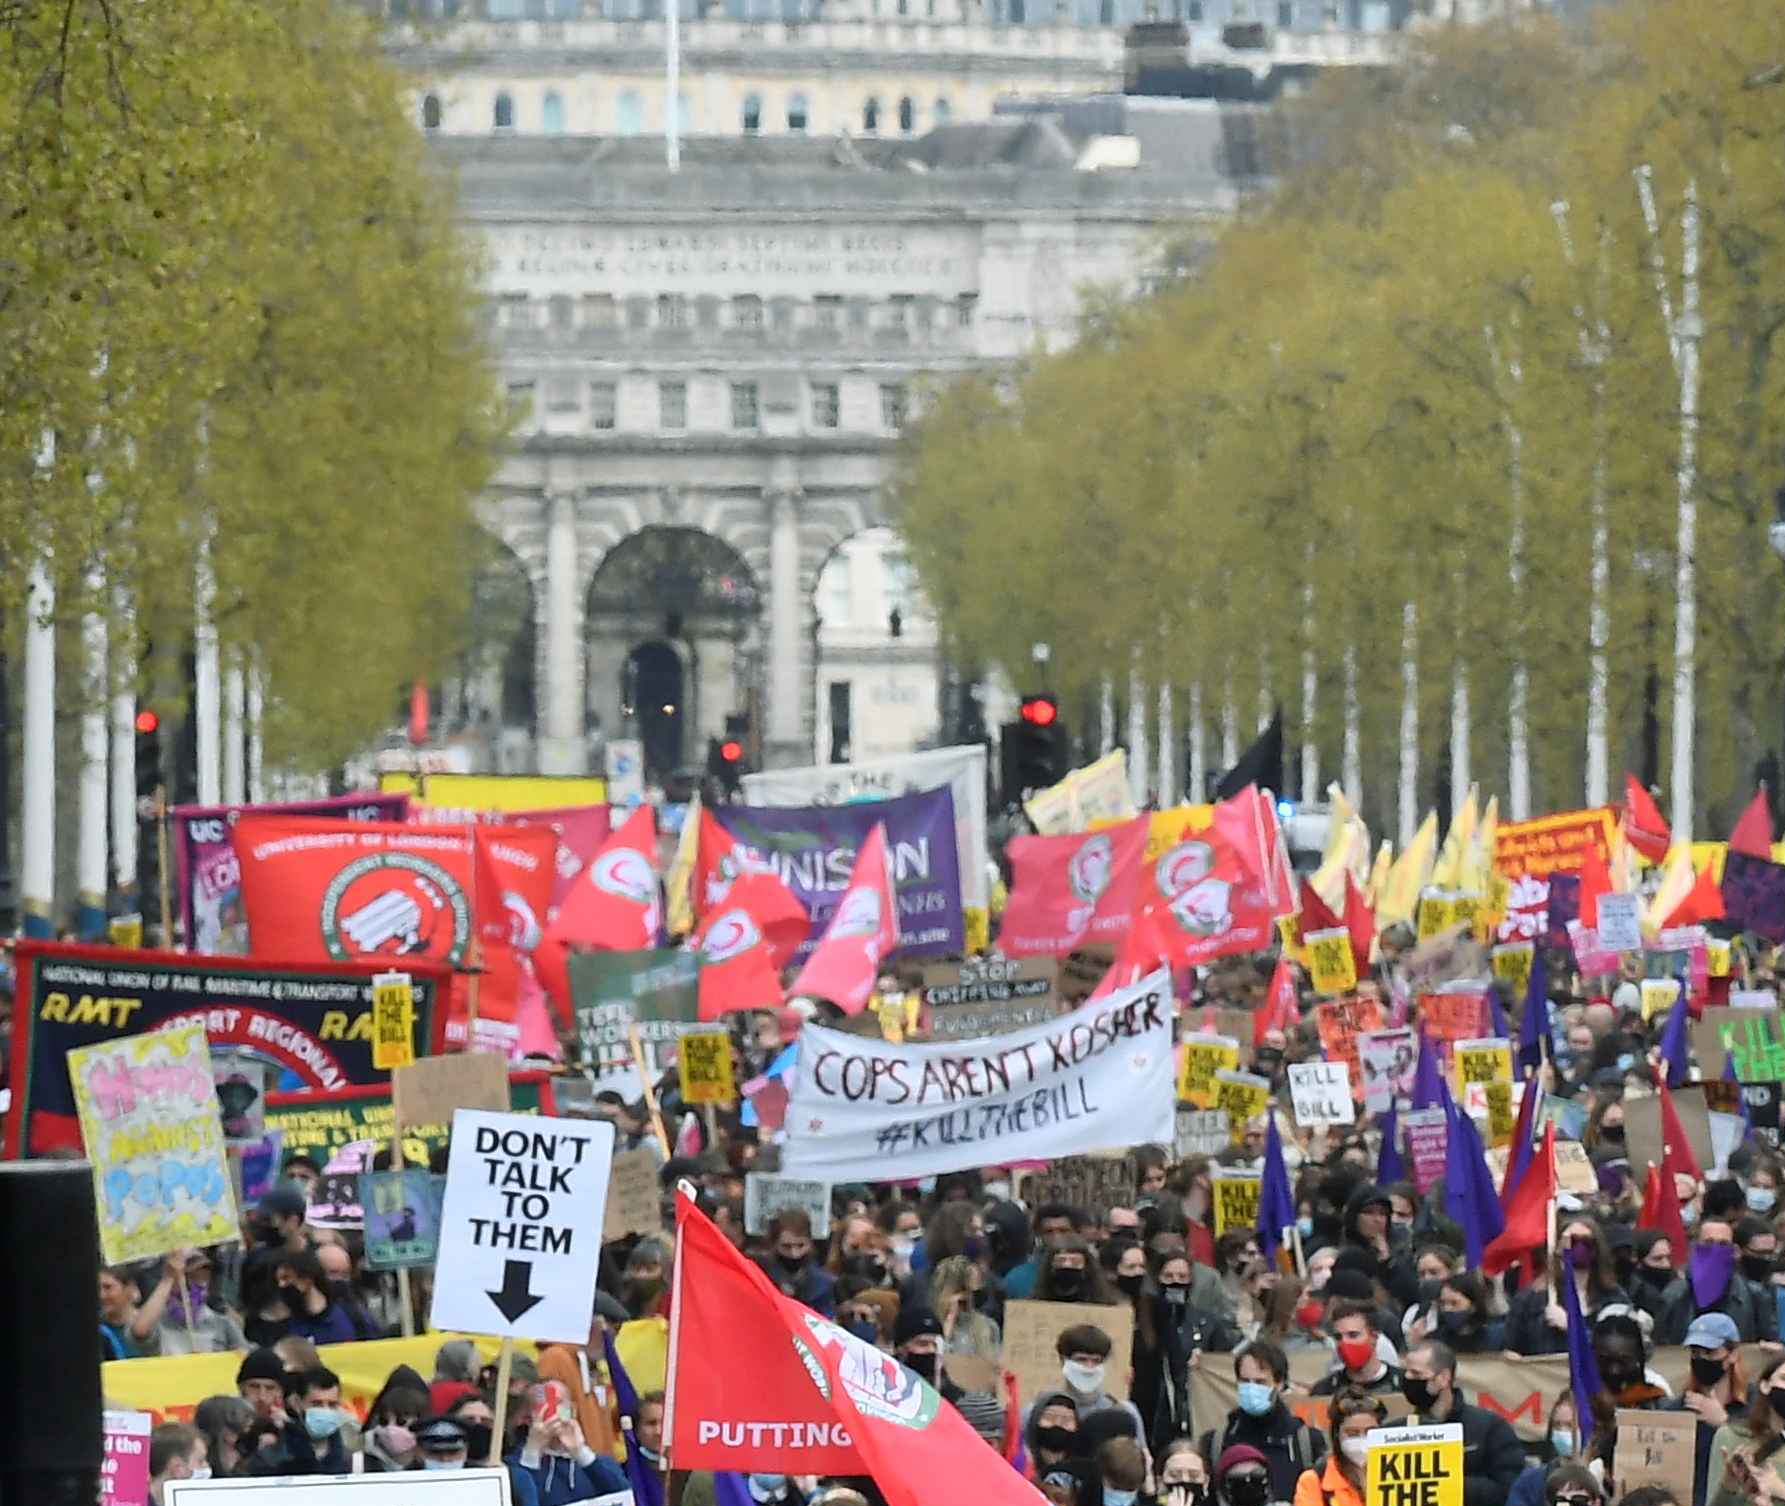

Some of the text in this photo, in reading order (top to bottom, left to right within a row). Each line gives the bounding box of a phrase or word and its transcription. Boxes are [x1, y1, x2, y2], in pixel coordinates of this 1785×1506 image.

[41, 993, 141, 1026] RMT
[815, 1052, 909, 1105] COPS
[1050, 992, 1164, 1073] KOSHER
[475, 1126, 591, 1163] DON'T
[484, 1158, 574, 1195] TALK
[500, 1190, 549, 1222] TO
[468, 1217, 574, 1255] THEM
[698, 1420, 853, 1448] PUTTING
[1379, 1450, 1450, 1482] KILL
